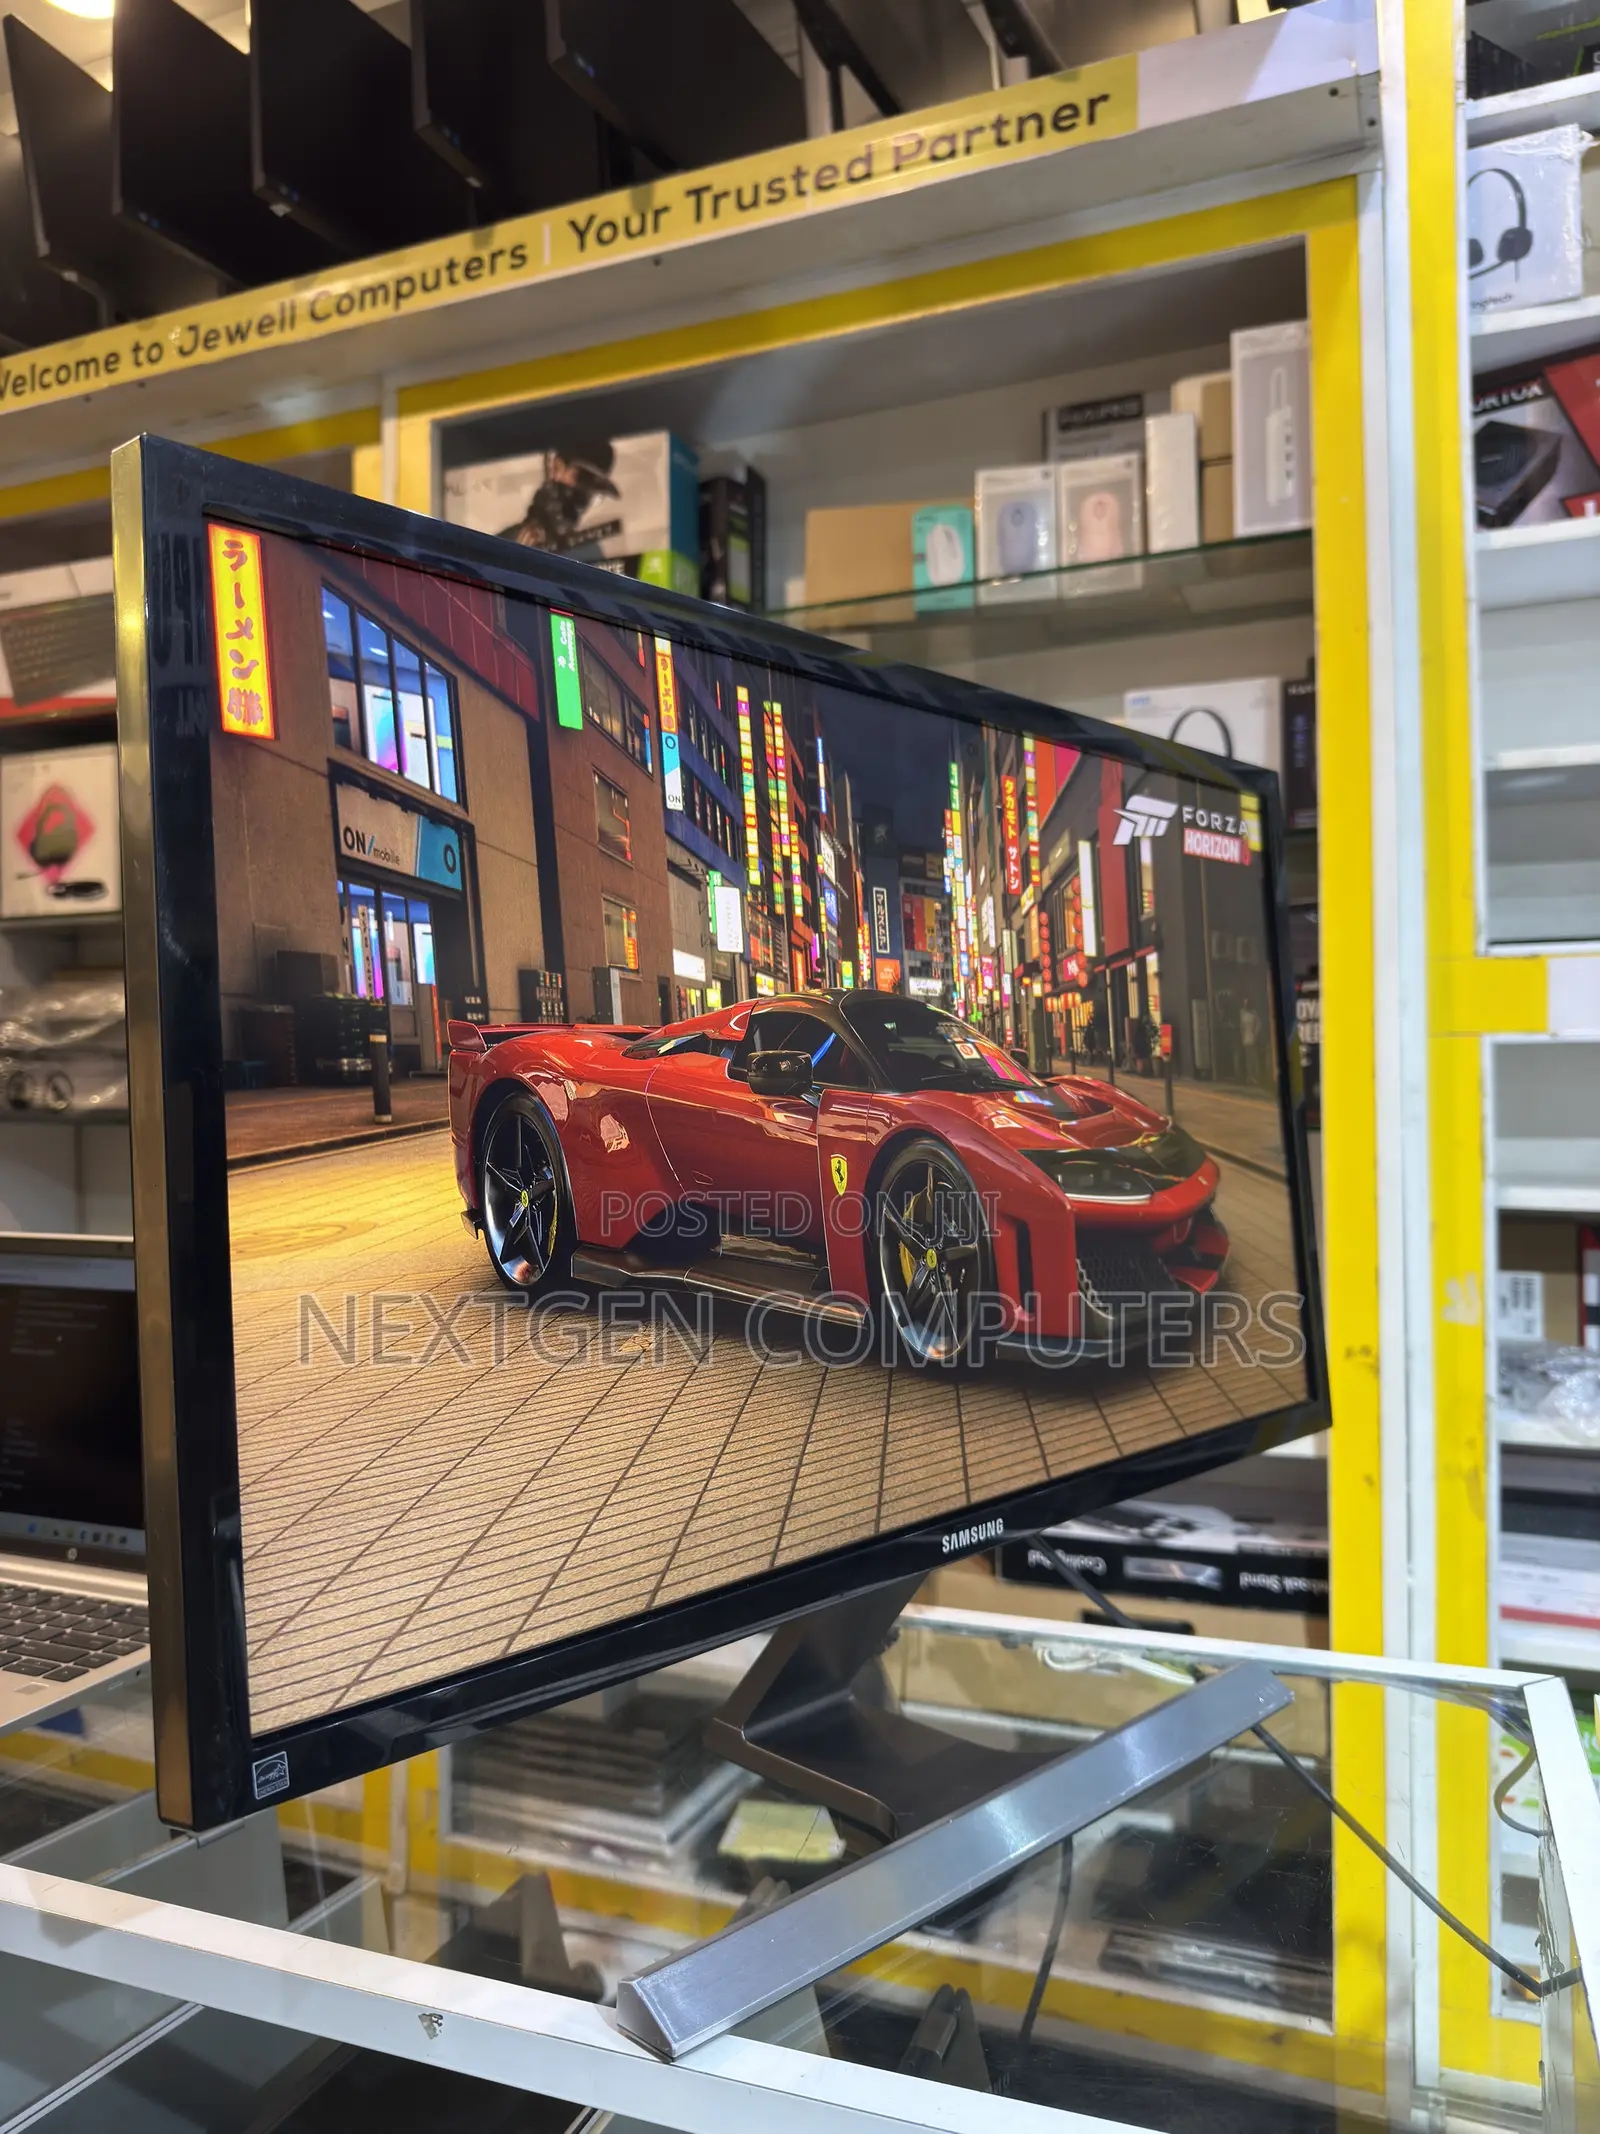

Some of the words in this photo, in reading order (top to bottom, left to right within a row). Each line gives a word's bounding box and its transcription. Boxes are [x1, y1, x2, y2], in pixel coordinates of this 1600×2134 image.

[131, 341, 164, 367] to
[178, 298, 297, 357] Jewell
[309, 243, 528, 323] Computers
[568, 205, 672, 253] Your
[685, 142, 874, 224] Trusted
[892, 93, 1112, 172] Partner
[1182, 806, 1249, 836] FORZA
[1184, 829, 1240, 865] HORIZON
[942, 1517, 1004, 1555] SAMSUNG
